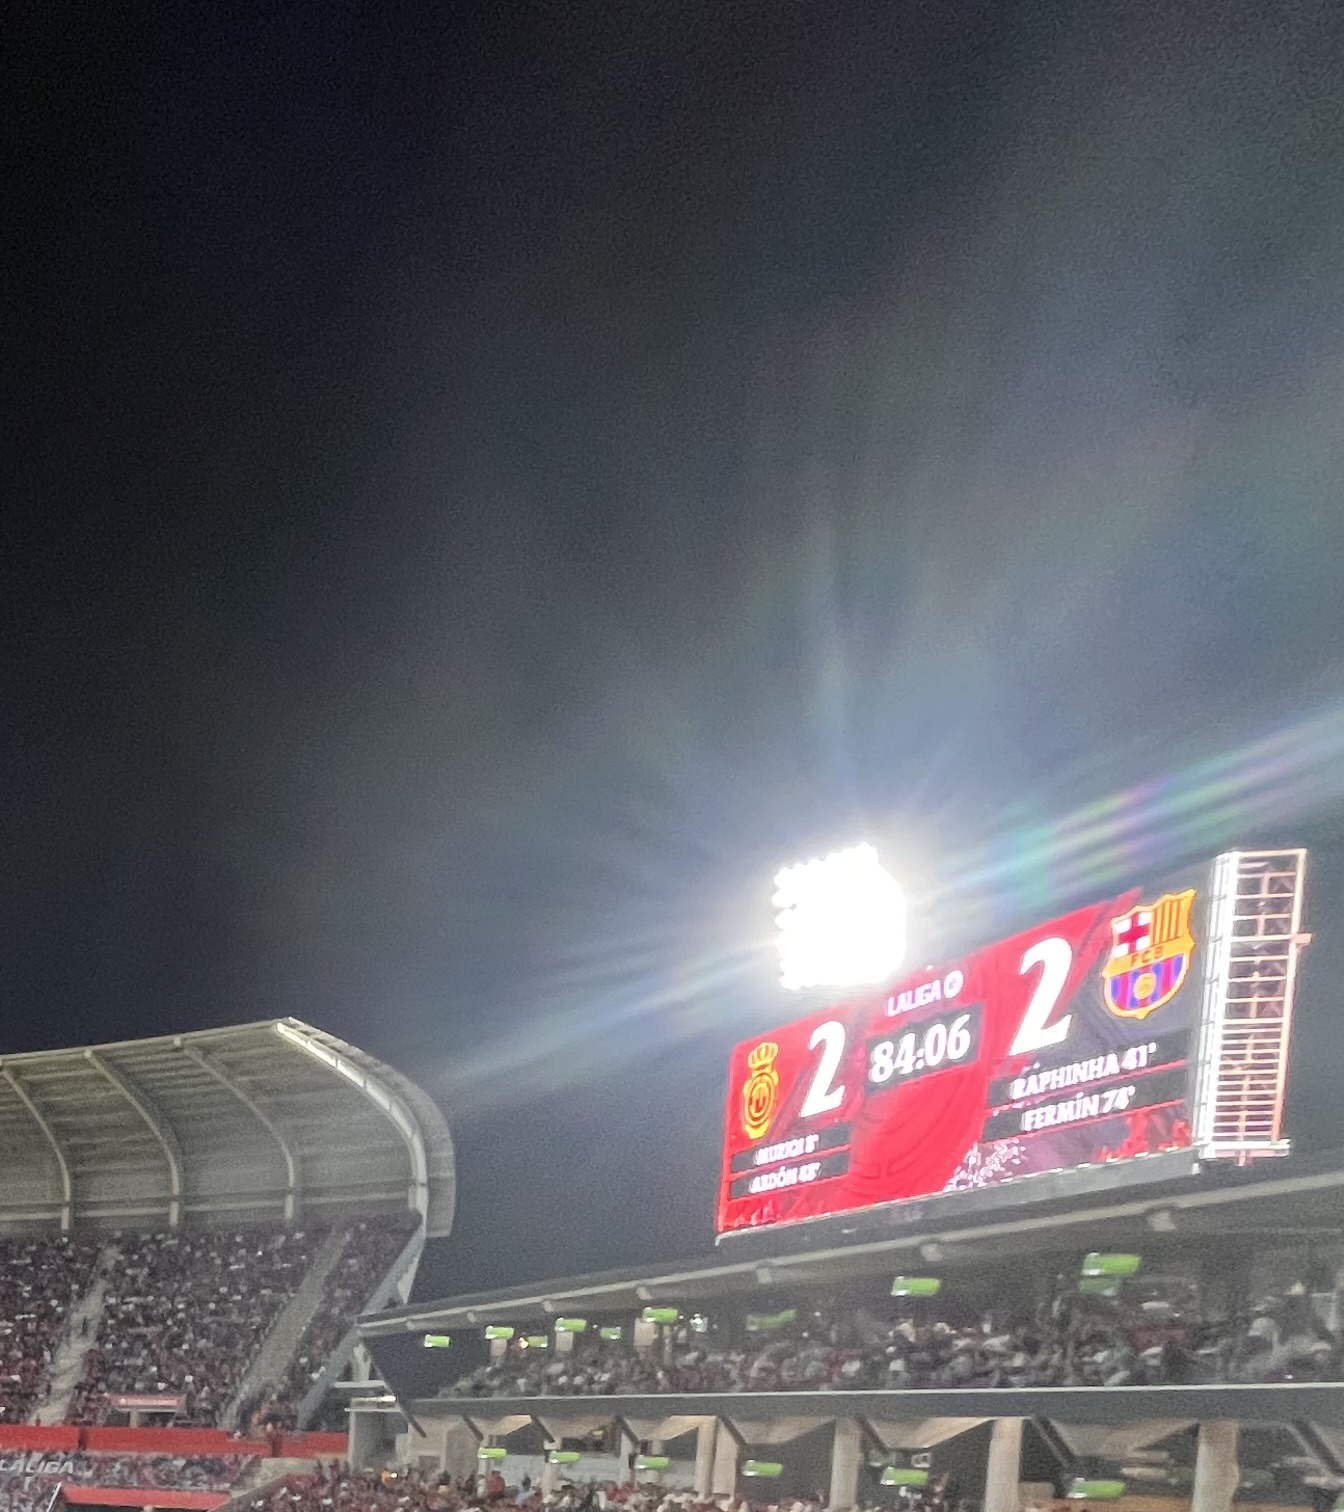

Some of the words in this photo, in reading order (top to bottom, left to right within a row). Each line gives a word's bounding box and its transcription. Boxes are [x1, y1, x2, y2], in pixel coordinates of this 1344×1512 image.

[885, 980, 942, 1017] LALIGA
[1008, 937, 1072, 1056] 2
[798, 1020, 846, 1118] 2
[868, 1014, 971, 1084] 84:06
[1010, 1053, 1120, 1101] RAPHINHA
[1021, 1091, 1099, 1131] FERMÍN
